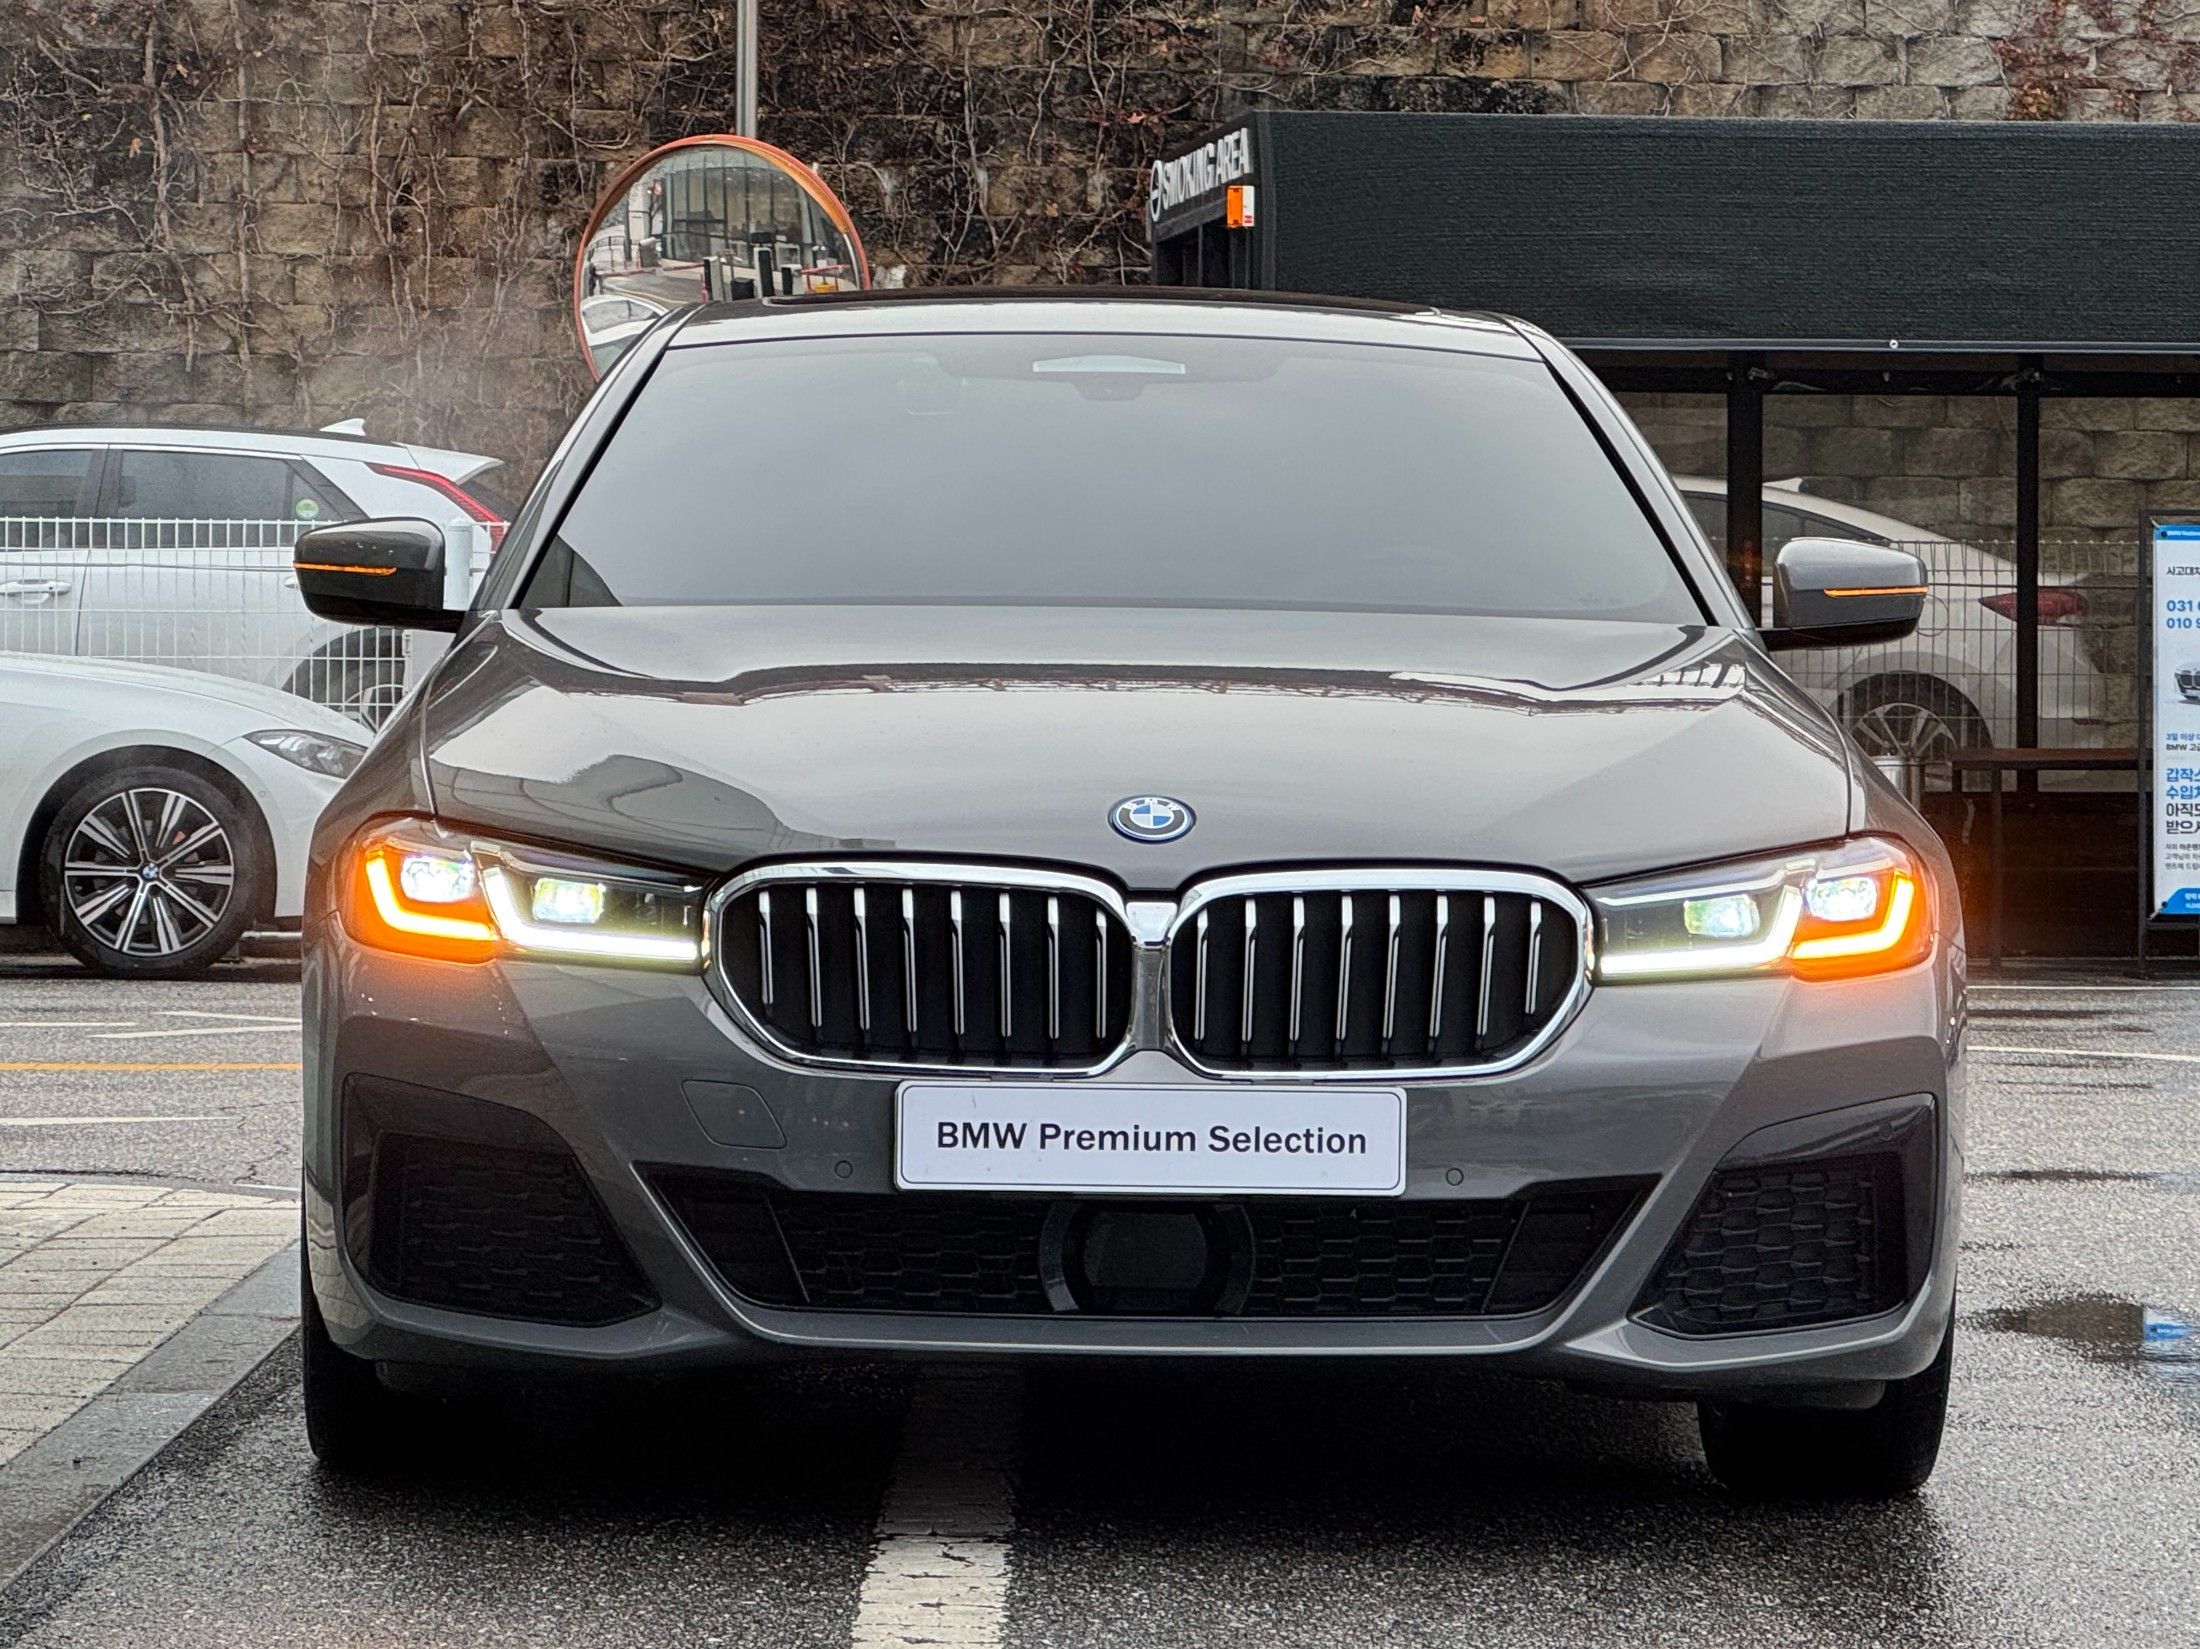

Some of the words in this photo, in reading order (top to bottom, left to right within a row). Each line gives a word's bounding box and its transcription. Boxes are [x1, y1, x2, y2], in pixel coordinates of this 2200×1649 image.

[1162, 143, 1215, 210] SMOKING
[1216, 127, 1250, 186] AREA
[2166, 599, 2193, 612] 031
[2166, 617, 2192, 629] 010
[2166, 743, 2187, 751] BMW
[936, 1121, 1028, 1150] BMW
[1038, 1123, 1196, 1153] Premium
[1208, 1125, 1368, 1155] Selection
